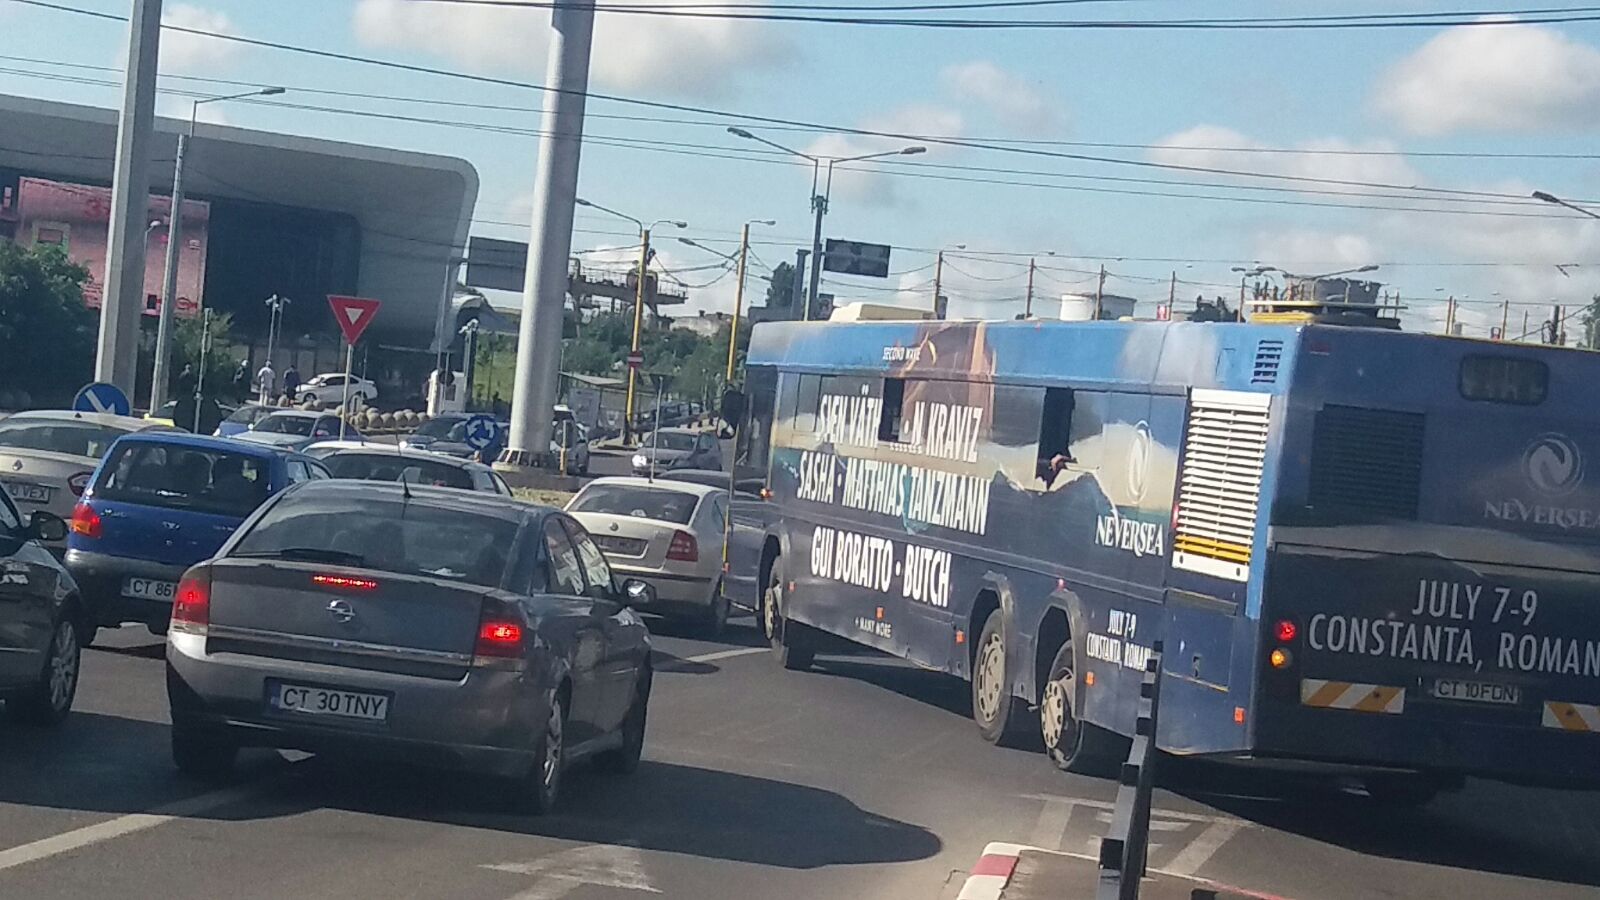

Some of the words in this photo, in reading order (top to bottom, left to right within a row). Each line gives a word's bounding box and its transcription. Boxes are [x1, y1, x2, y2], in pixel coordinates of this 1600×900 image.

[926, 402, 983, 463] KRAVIZ
[797, 450, 836, 505] SASHA
[842, 456, 907, 518] MATTHIAS
[908, 465, 991, 536] TANZMANN
[1484, 498, 1600, 529] NEVERSE
[1095, 515, 1163, 558] NEVERSEA
[811, 525, 835, 579] GUI
[834, 530, 893, 593] BORATTO
[903, 543, 951, 608] BUTCH
[133, 579, 152, 594] CT
[1412, 579, 1482, 621] JULY
[1492, 587, 1538, 626] 7-9
[1107, 608, 1124, 636] JULY
[1123, 642, 1152, 672] ROMAN
[1308, 613, 1483, 673] CONSTANTA,
[283, 688, 309, 709] CT
[1438, 681, 1459, 697] CT
